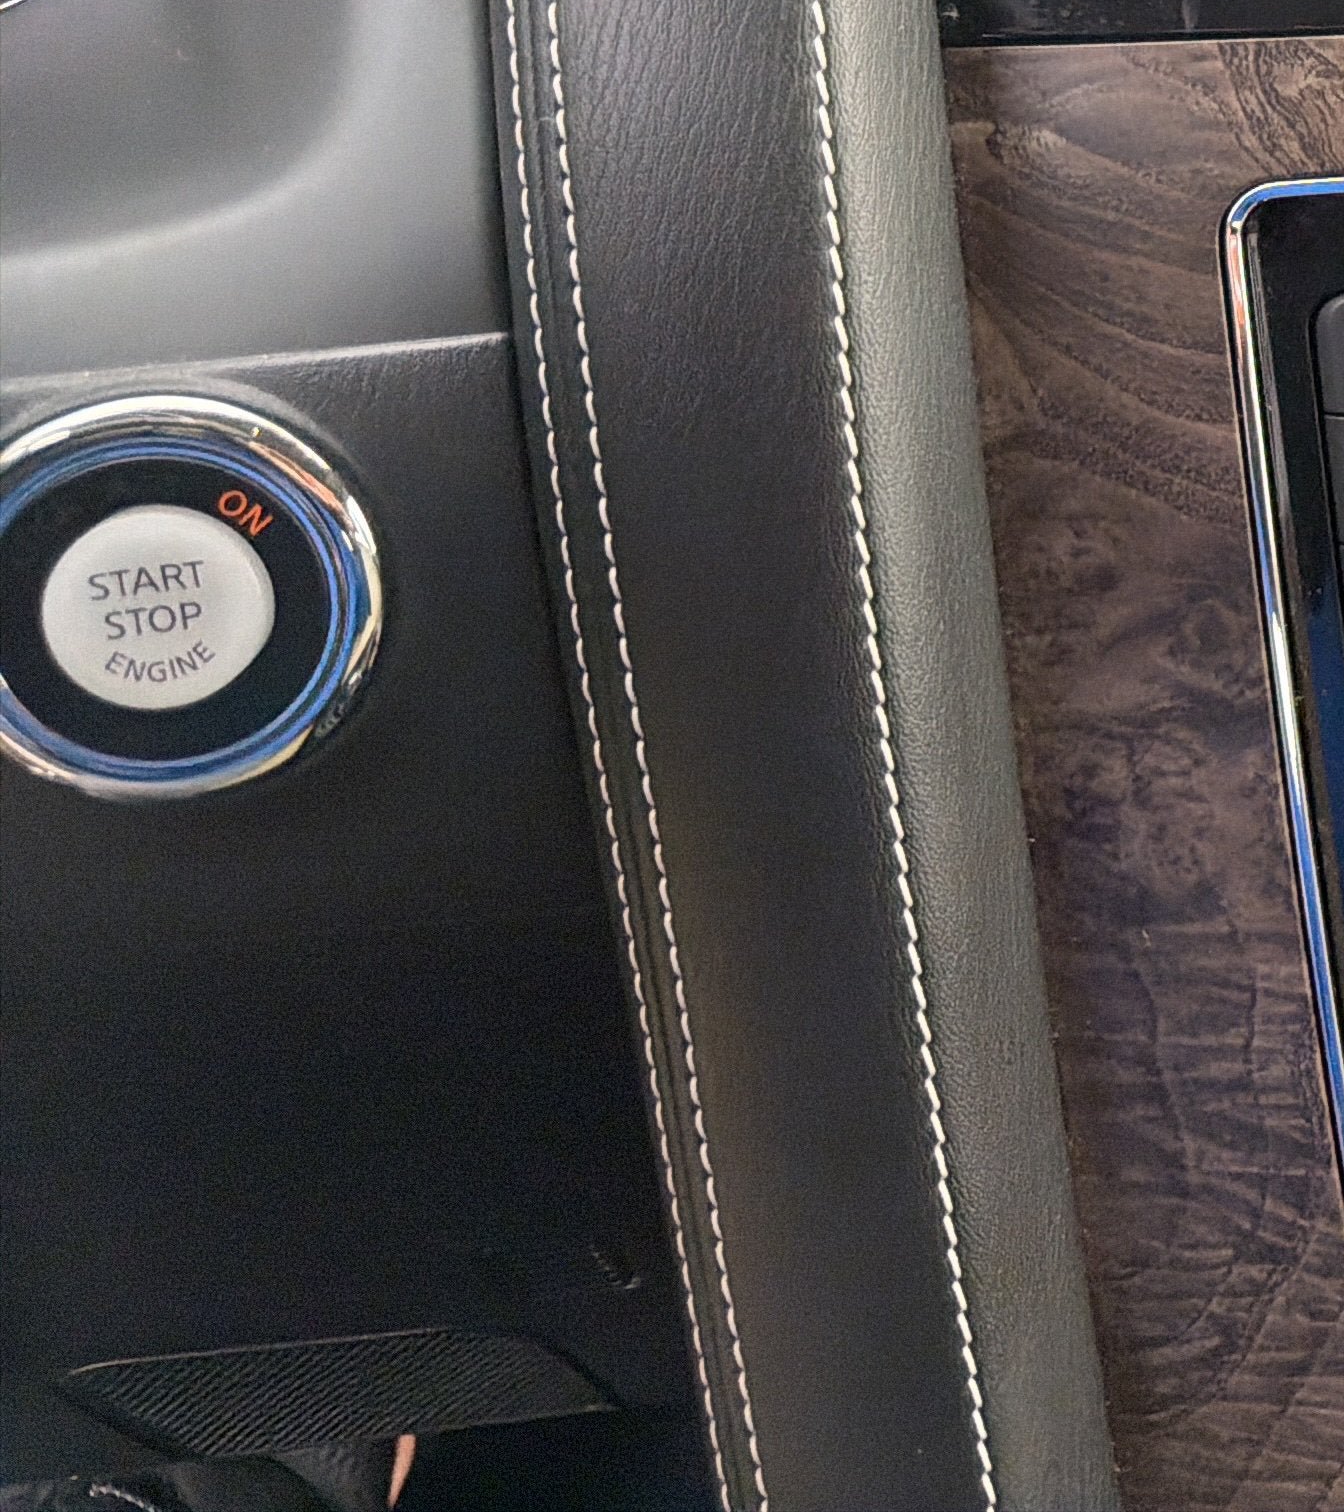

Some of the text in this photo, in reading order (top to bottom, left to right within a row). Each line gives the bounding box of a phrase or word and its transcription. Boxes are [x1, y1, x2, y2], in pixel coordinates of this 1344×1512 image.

[216, 489, 273, 538] ON
[88, 560, 206, 602] START
[104, 600, 204, 640] STOP
[105, 639, 216, 684] ENGINE
